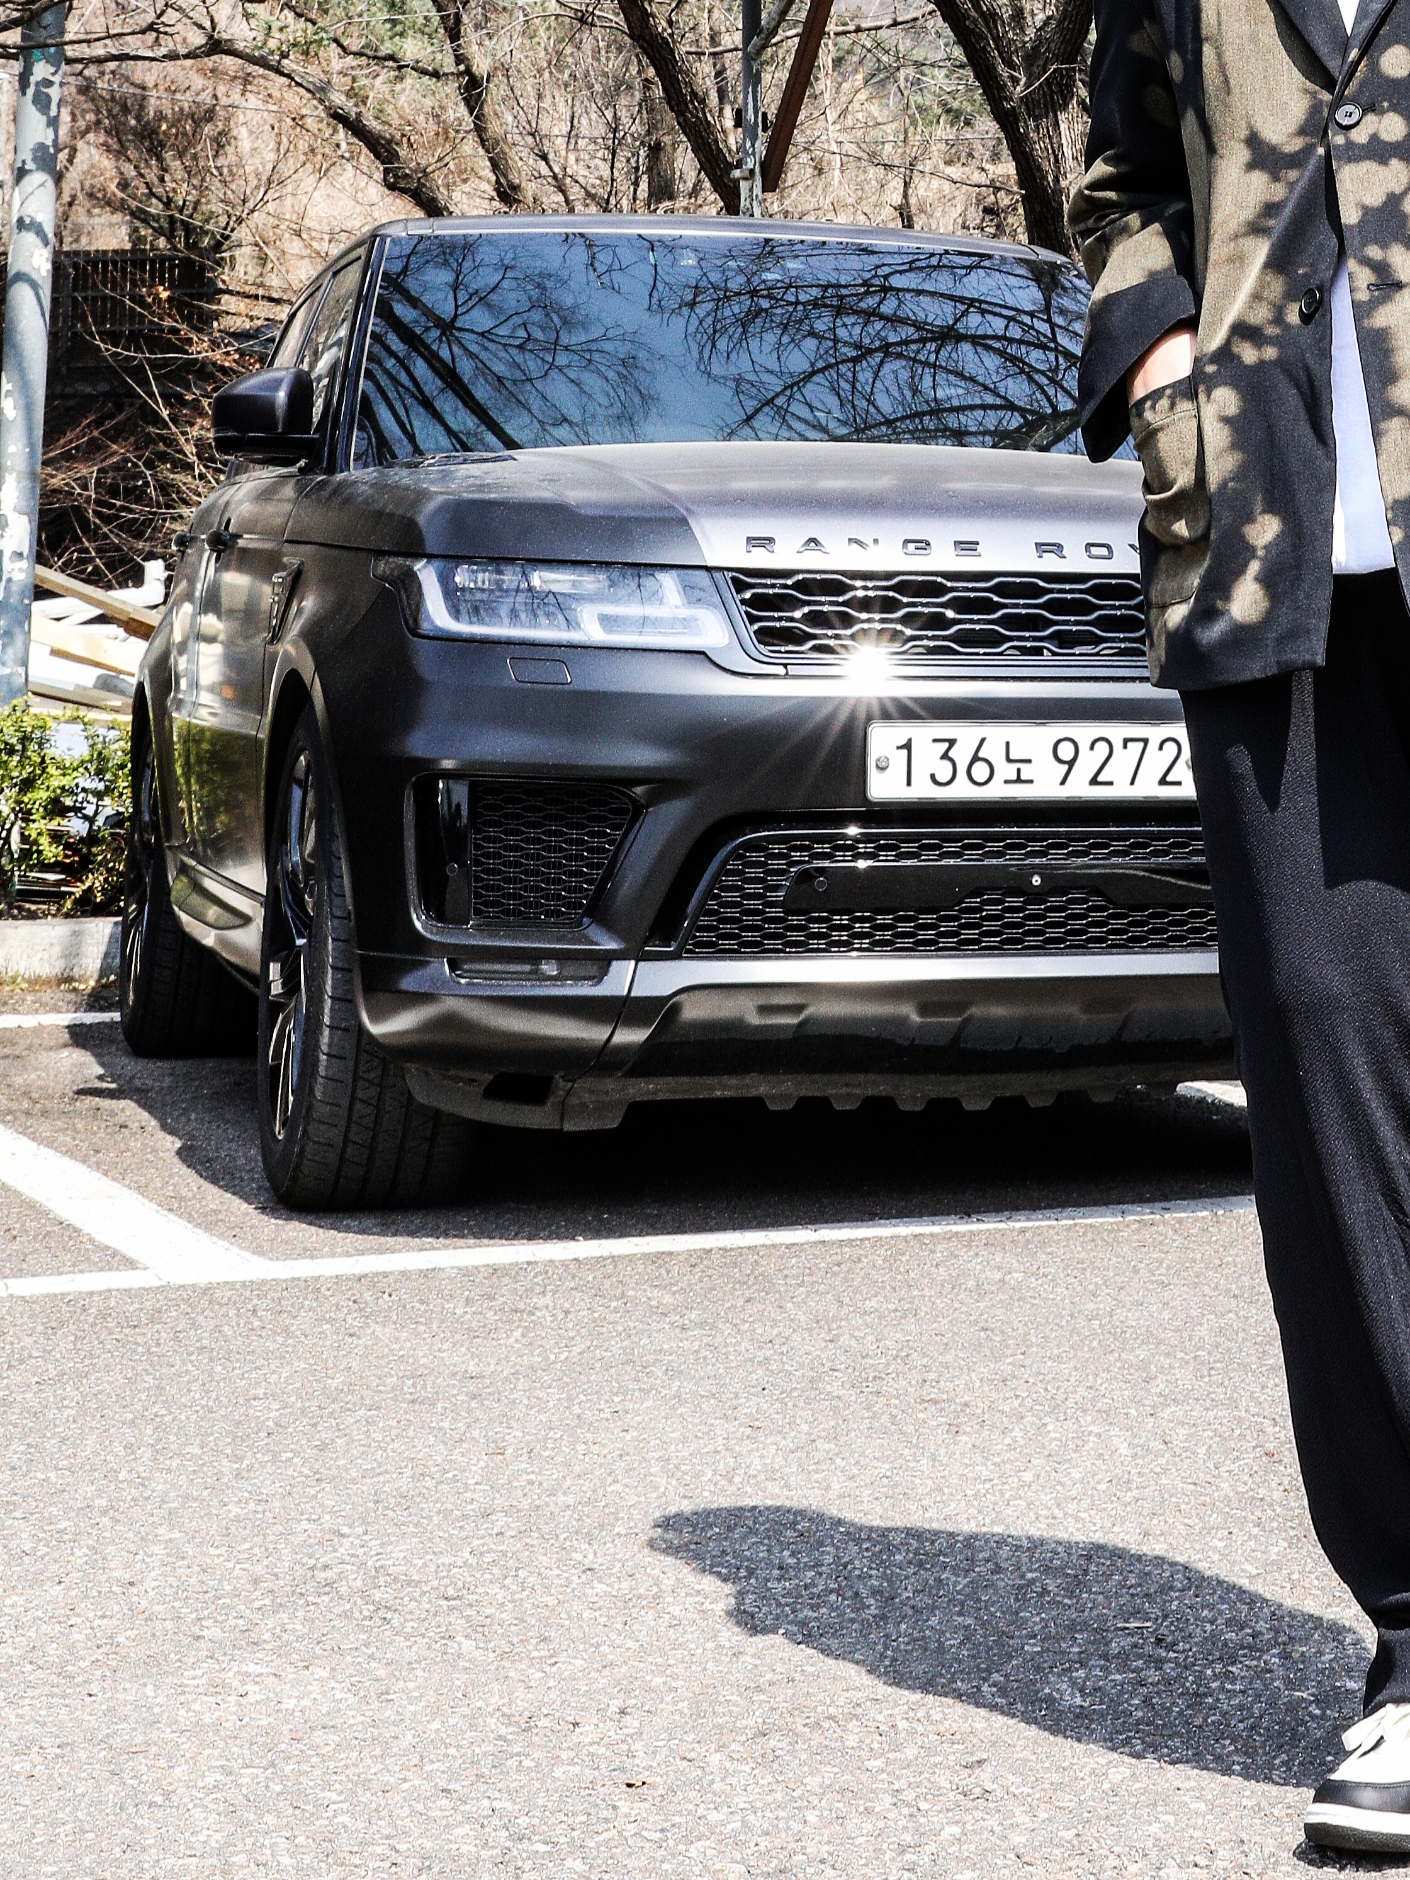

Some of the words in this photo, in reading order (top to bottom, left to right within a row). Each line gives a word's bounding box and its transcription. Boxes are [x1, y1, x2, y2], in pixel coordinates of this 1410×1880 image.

[745, 535, 982, 558] RANGE
[1034, 541, 1140, 560] RO
[895, 736, 1035, 788] 136노
[1052, 736, 1183, 788] 9272
